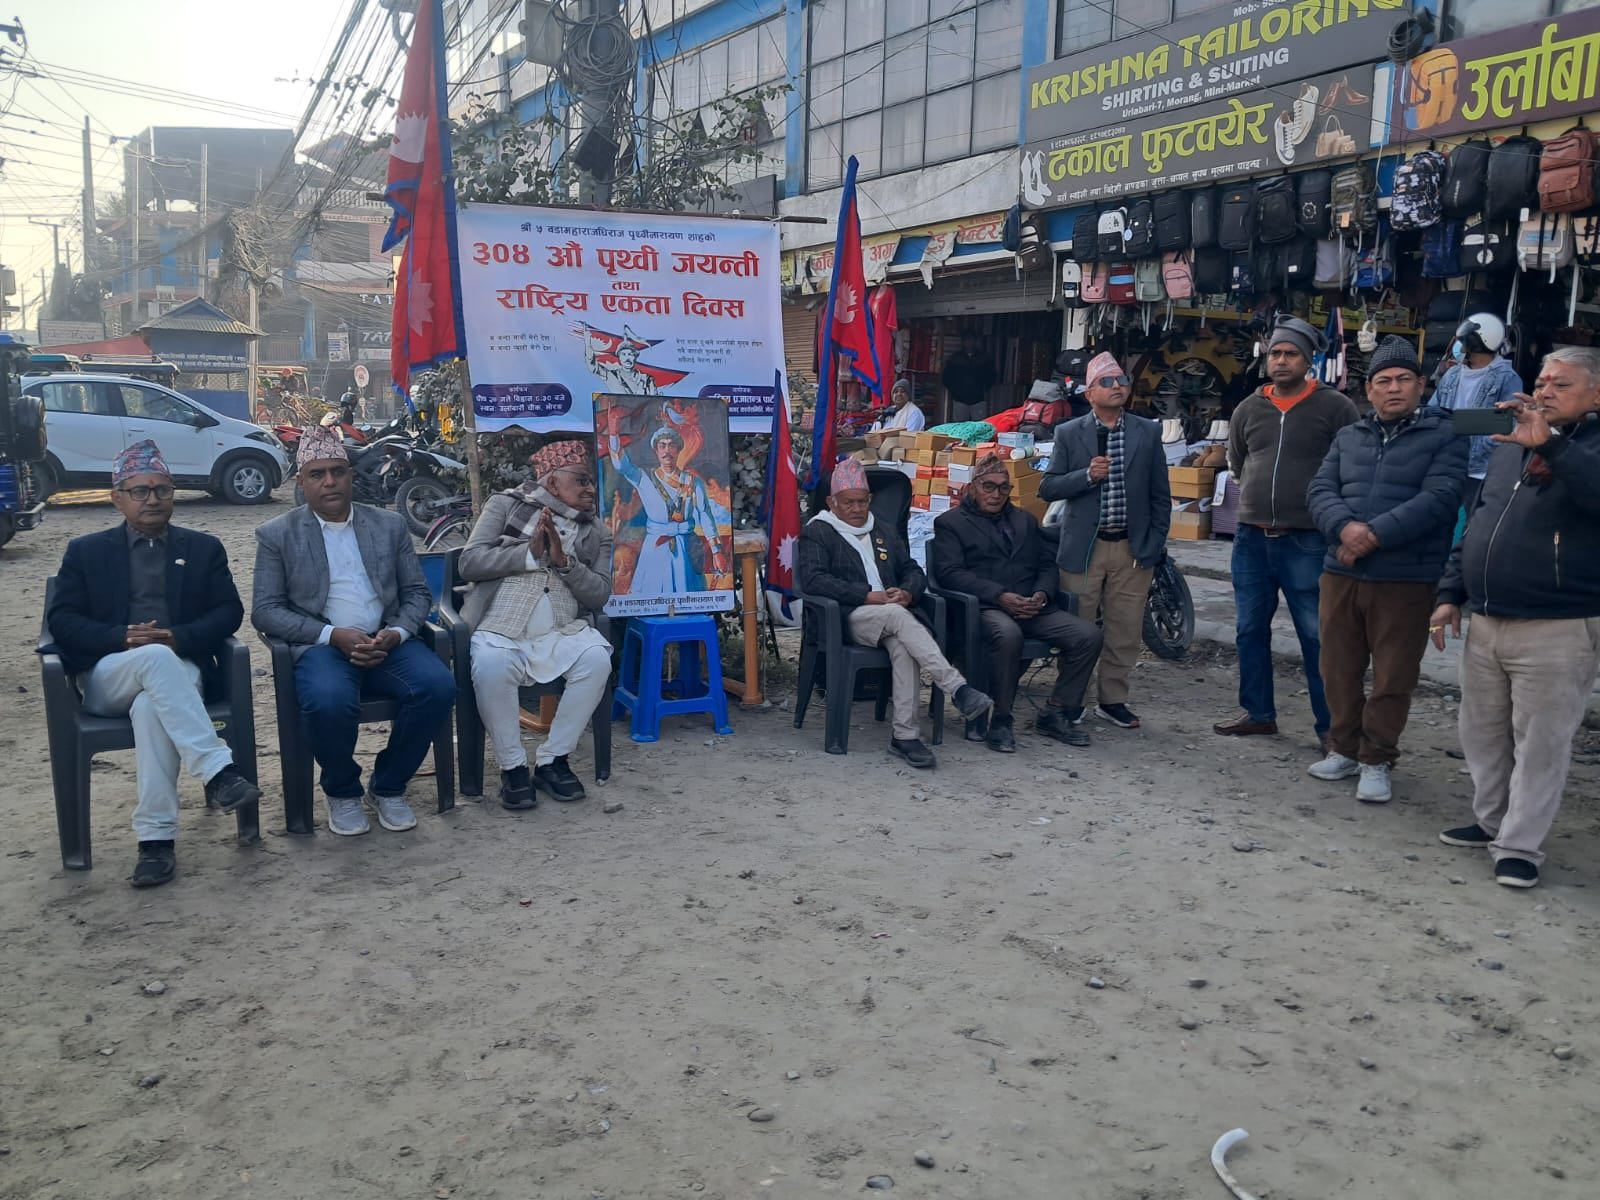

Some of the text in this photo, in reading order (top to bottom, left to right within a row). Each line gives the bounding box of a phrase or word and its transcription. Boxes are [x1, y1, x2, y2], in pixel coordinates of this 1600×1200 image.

[1030, 44, 1170, 109] KRISHNA
[1102, 47, 1290, 111] SHIRTING & SUITING
[1166, 93, 1202, 107] Morang,
[1204, 75, 1261, 98] Mini-Market
[1048, 135, 1133, 181] ढकाल
[472, 242, 530, 266] ३०४
[596, 245, 660, 276] पृथ्वी
[671, 250, 760, 277] जयन्ती
[496, 284, 744, 318] राष्ट्रिय एकता दिवस
[612, 281, 640, 291] तथा
